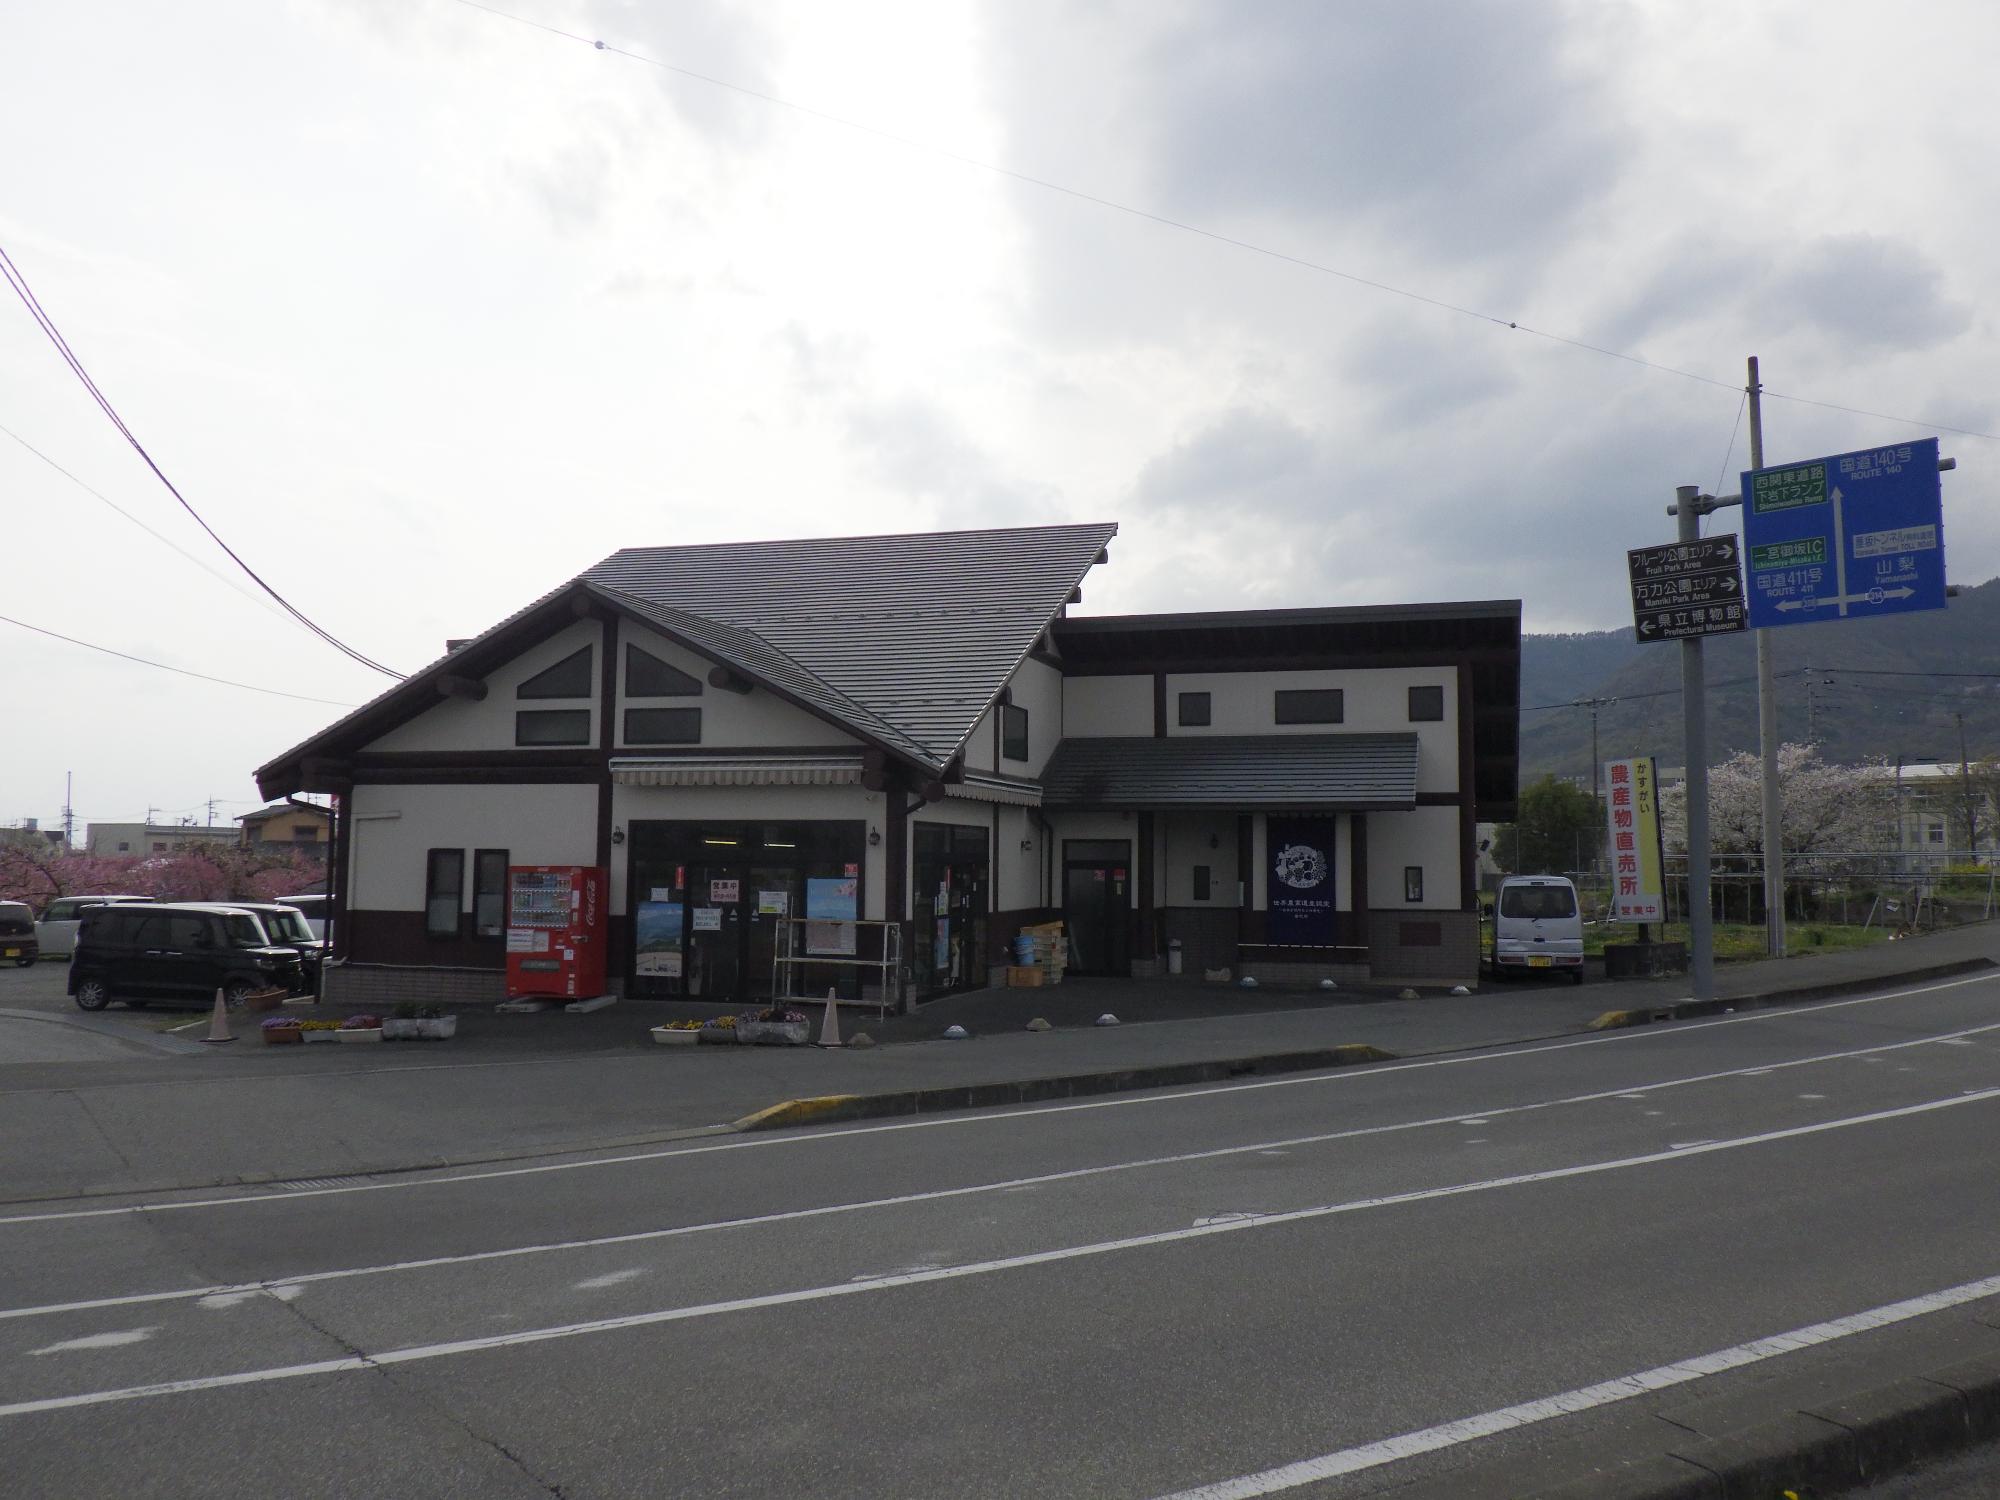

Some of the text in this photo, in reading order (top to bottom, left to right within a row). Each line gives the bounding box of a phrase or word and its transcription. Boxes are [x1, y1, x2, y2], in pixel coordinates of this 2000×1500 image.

[1840, 447, 1912, 473] 国道140号
[1756, 466, 1824, 489] 西関東道路
[1851, 464, 1901, 480] ROUTE 140
[1756, 480, 1825, 502] 下岩下ランプ
[1632, 544, 1713, 568] フルーツ公園エリア
[1877, 557, 1915, 574] 山梨
[1646, 561, 1701, 575] Fruit Park Area
[1757, 567, 1823, 589] 国道411号
[1635, 577, 1717, 599] 万力公園エリア
[1645, 591, 1710, 607] Manriki Park Area
[1767, 585, 1813, 597] ROUTE 411
[1658, 605, 1741, 627] 県立博物館
[1664, 622, 1738, 637] Prefectural Museum
[1637, 763, 1650, 814] かすがい
[1611, 764, 1637, 895] 農産物直売所
[586, 879, 598, 927] Coca-Cola
[1620, 905, 1656, 915] 営業中
